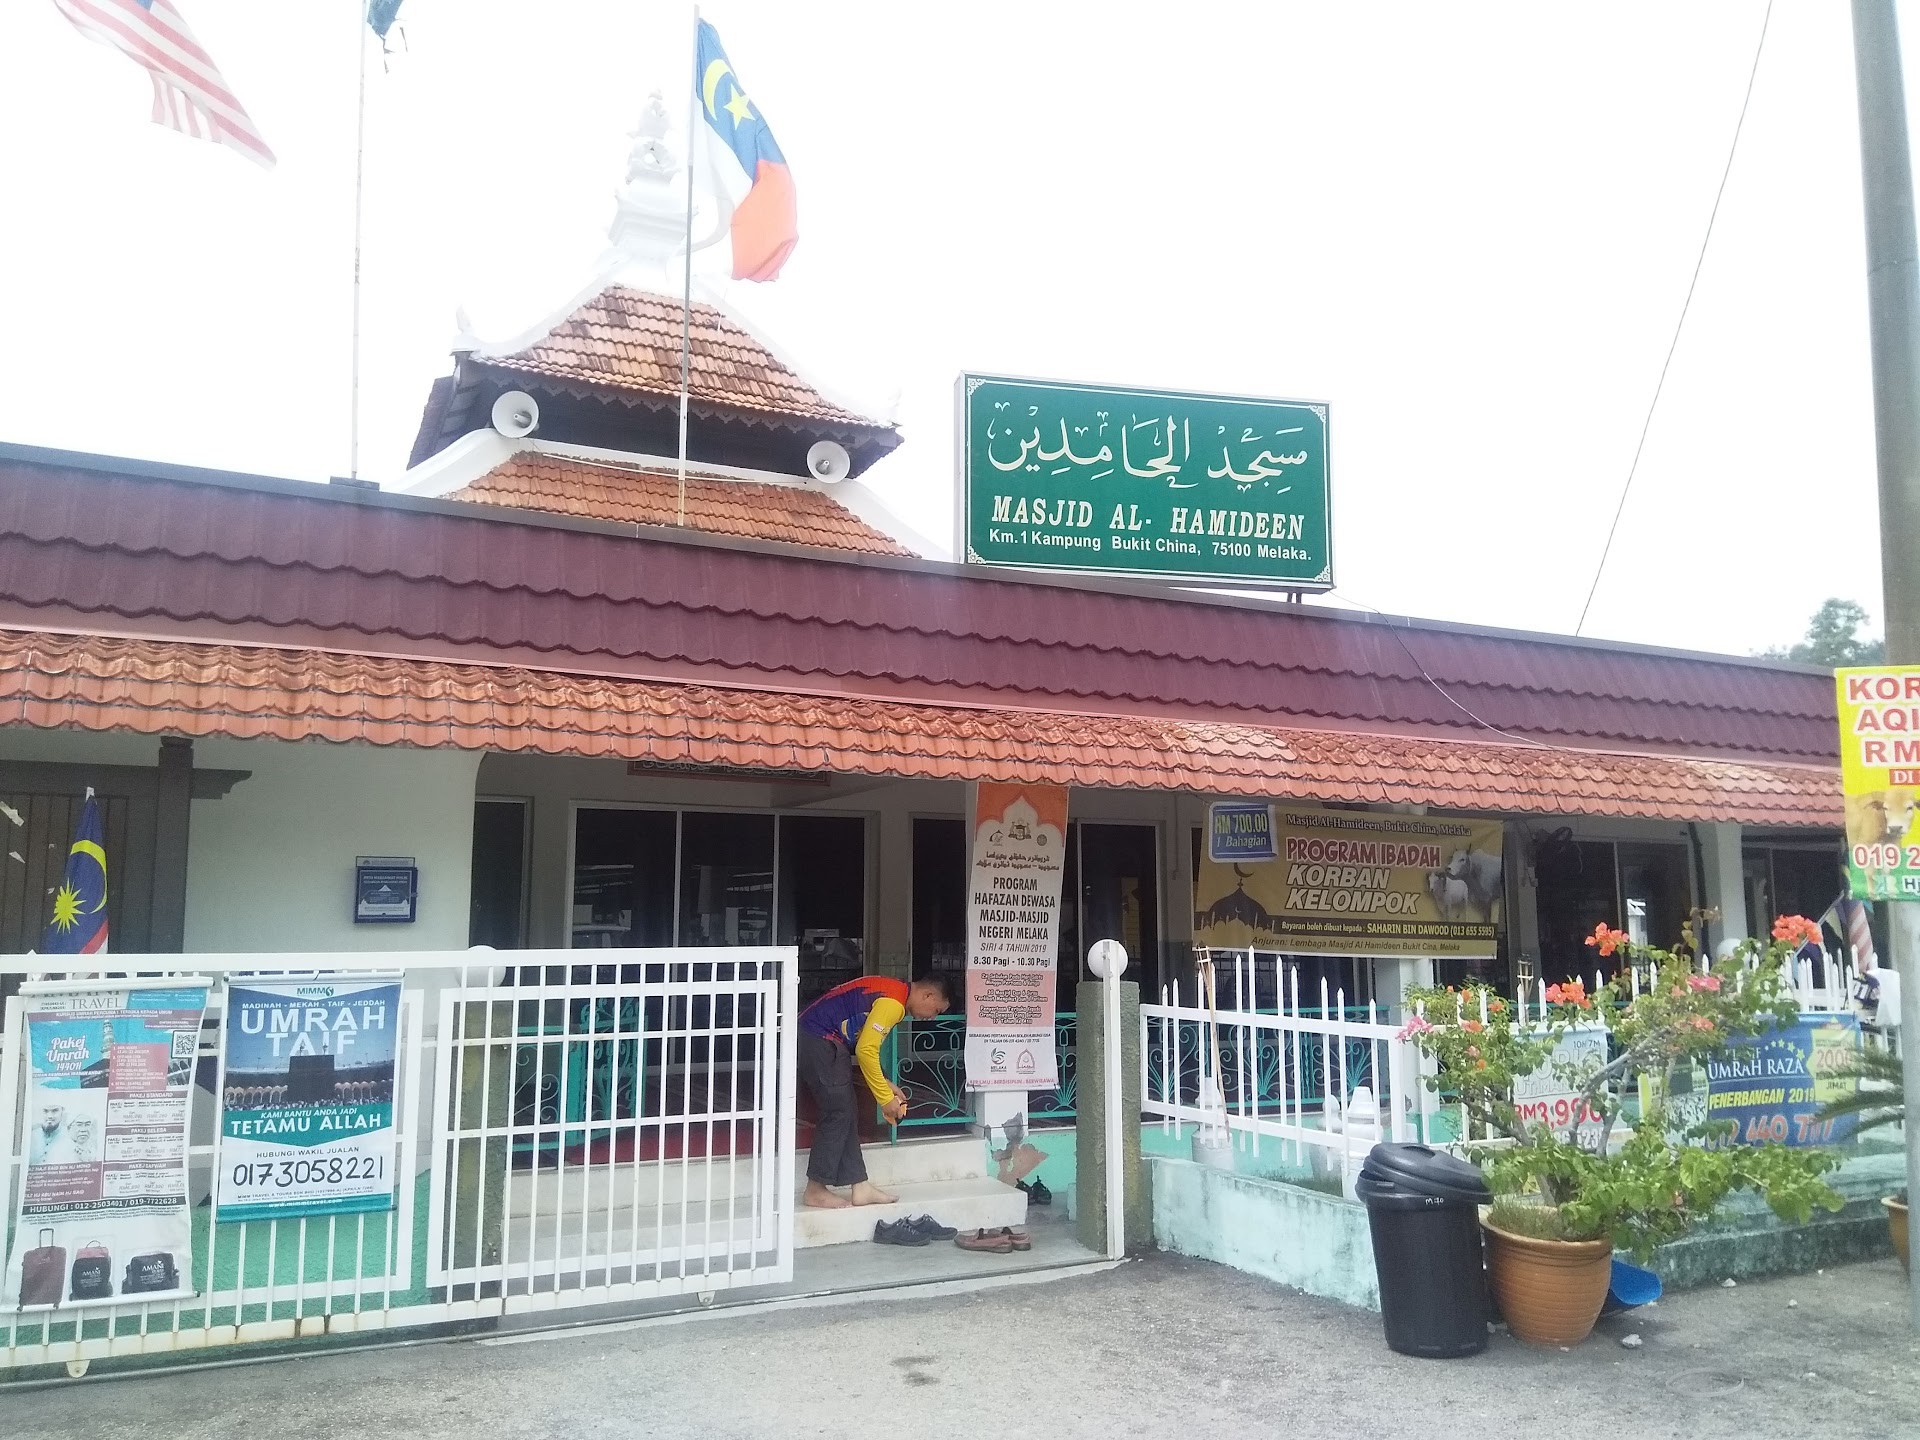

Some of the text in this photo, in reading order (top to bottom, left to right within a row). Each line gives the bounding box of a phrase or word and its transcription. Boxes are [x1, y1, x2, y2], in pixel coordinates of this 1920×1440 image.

[991, 495, 1094, 529] MASJID
[1170, 507, 1305, 541] HAMIDEEN
[1031, 531, 1101, 552] Kampung
[1111, 535, 1151, 551] Bukit
[1155, 539, 1201, 556] China,
[1212, 542, 1251, 557] 75100
[1257, 544, 1312, 561] Melaka.
[1215, 813, 1267, 834] RM 700.00
[1286, 814, 1318, 829] Masjid
[1385, 821, 1409, 833] Bukit
[1411, 823, 1440, 836] China,
[1440, 825, 1471, 836] Melaka
[1225, 835, 1266, 849] Bahagian
[1287, 838, 1441, 868] PROGRAM IBADAH
[1854, 846, 1898, 867] 019
[993, 877, 1037, 891] PROGRAM
[1286, 864, 1390, 889] KORBAN
[974, 892, 1055, 908] HAFAZAN DEWASA
[1285, 888, 1420, 914] KELOMPOK
[980, 909, 1049, 924] MASJID-MASJID
[979, 925, 1049, 940] NEGERI MELAKA
[1281, 921, 1305, 931] Bayaran
[1306, 922, 1323, 931] boleh
[1323, 923, 1342, 932] dibuat
[1367, 924, 1401, 934] SAHARIN
[1402, 925, 1417, 935] BIN
[1418, 925, 1449, 936] DAWOOD
[1450, 926, 1465, 937] (013
[1466, 926, 1477, 936] 655
[1478, 926, 1494, 937] 5595)
[980, 942, 1047, 953] SIRI 4 TAHUN 2019
[1250, 936, 1287, 946] Anjuran:
[1290, 938, 1327, 949] Lembaga
[1328, 940, 1354, 949] Masjid
[1364, 942, 1401, 950] Hamideen
[1402, 942, 1421, 950] Bukit
[973, 956, 990, 965] 8.30
[993, 956, 1009, 967] Pagi
[1017, 957, 1035, 966] 10.30
[1036, 957, 1050, 967] Pagi
[71, 997, 122, 1010] TRAVEL
[241, 1006, 386, 1034] UMRAH
[51, 1036, 86, 1050] Pakej
[265, 1030, 357, 1057] TAIF
[46, 1049, 89, 1062] Umrah
[1708, 1058, 1804, 1080] UMRAH RAZA
[1709, 1088, 1785, 1110] PENERBANGAN
[260, 1111, 282, 1119] KAMI
[284, 1110, 311, 1118] BANTU
[340, 1107, 357, 1115] JADI
[231, 1114, 380, 1135] TETAMU ALLAH
[298, 1148, 323, 1156] WAKIL
[327, 1146, 359, 1154] JUALAN
[233, 1155, 383, 1188] 0173058221
[30, 1203, 69, 1213] HUBUNGI
